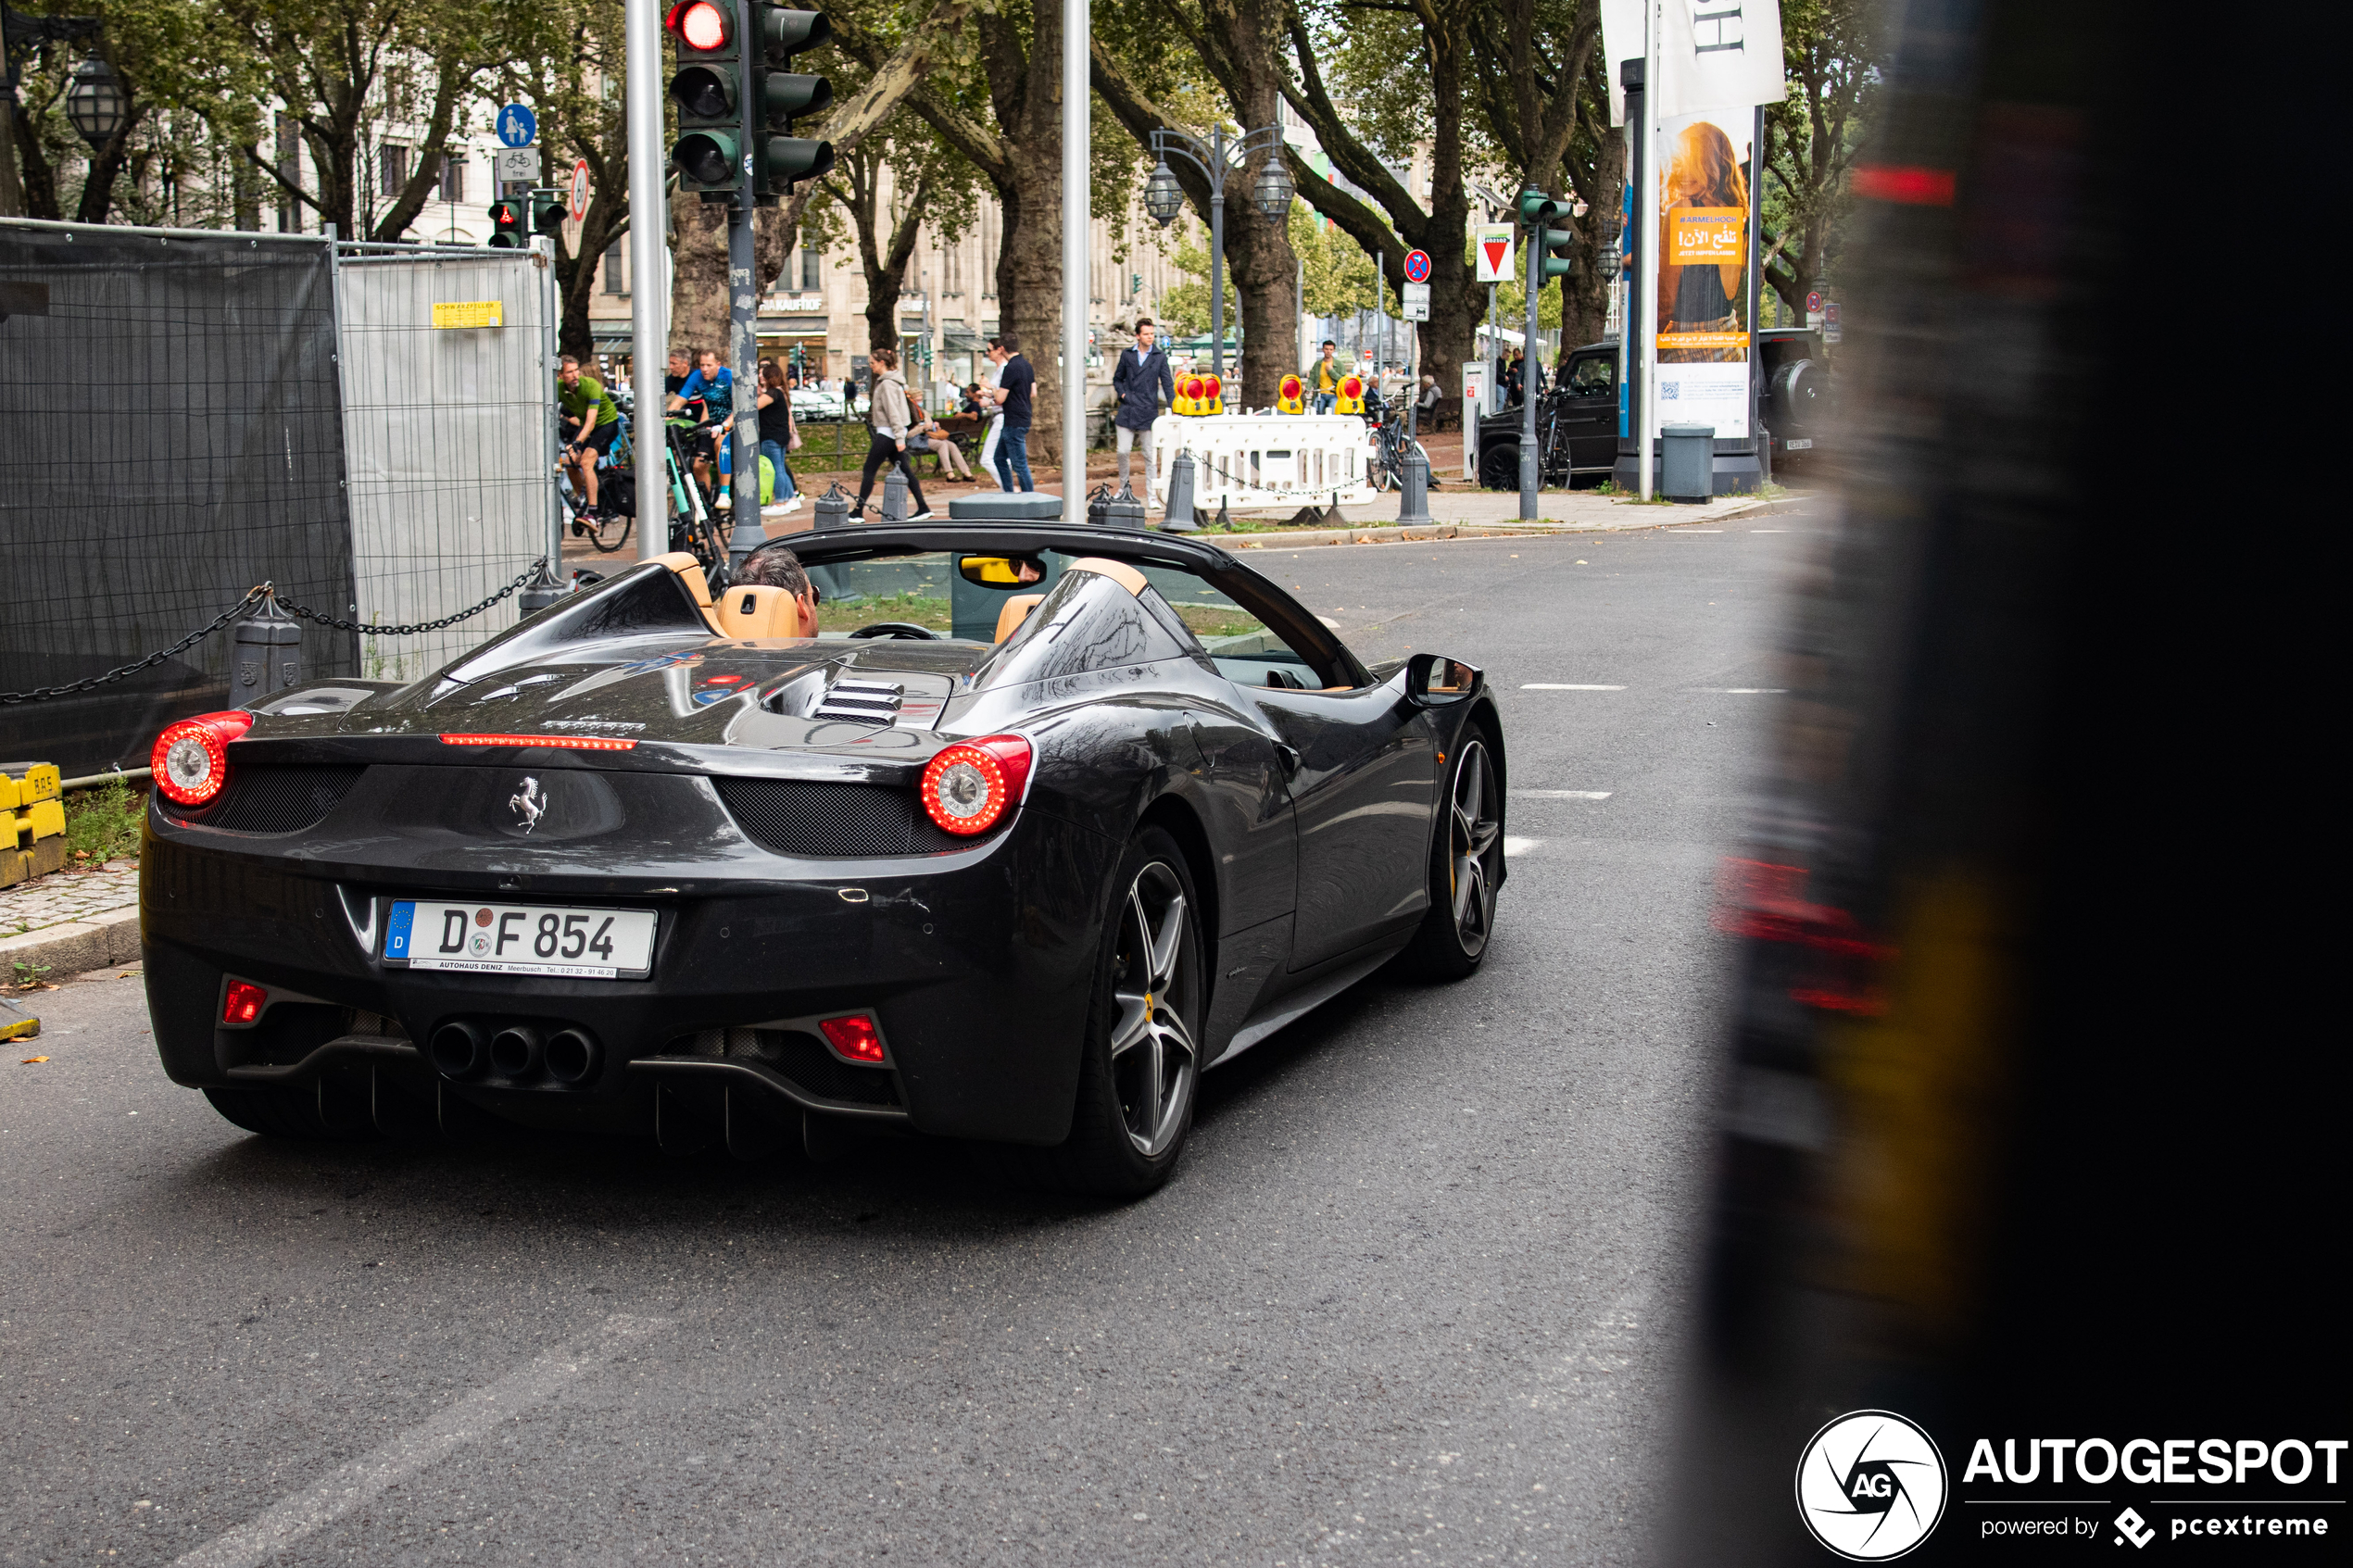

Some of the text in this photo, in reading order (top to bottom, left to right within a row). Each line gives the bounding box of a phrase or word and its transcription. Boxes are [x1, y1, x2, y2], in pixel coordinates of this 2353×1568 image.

[439, 909, 468, 953] D
[495, 912, 527, 956] F
[534, 913, 615, 960] 854
[395, 936, 404, 949] D
[439, 961, 479, 970] AUTOHAUS
